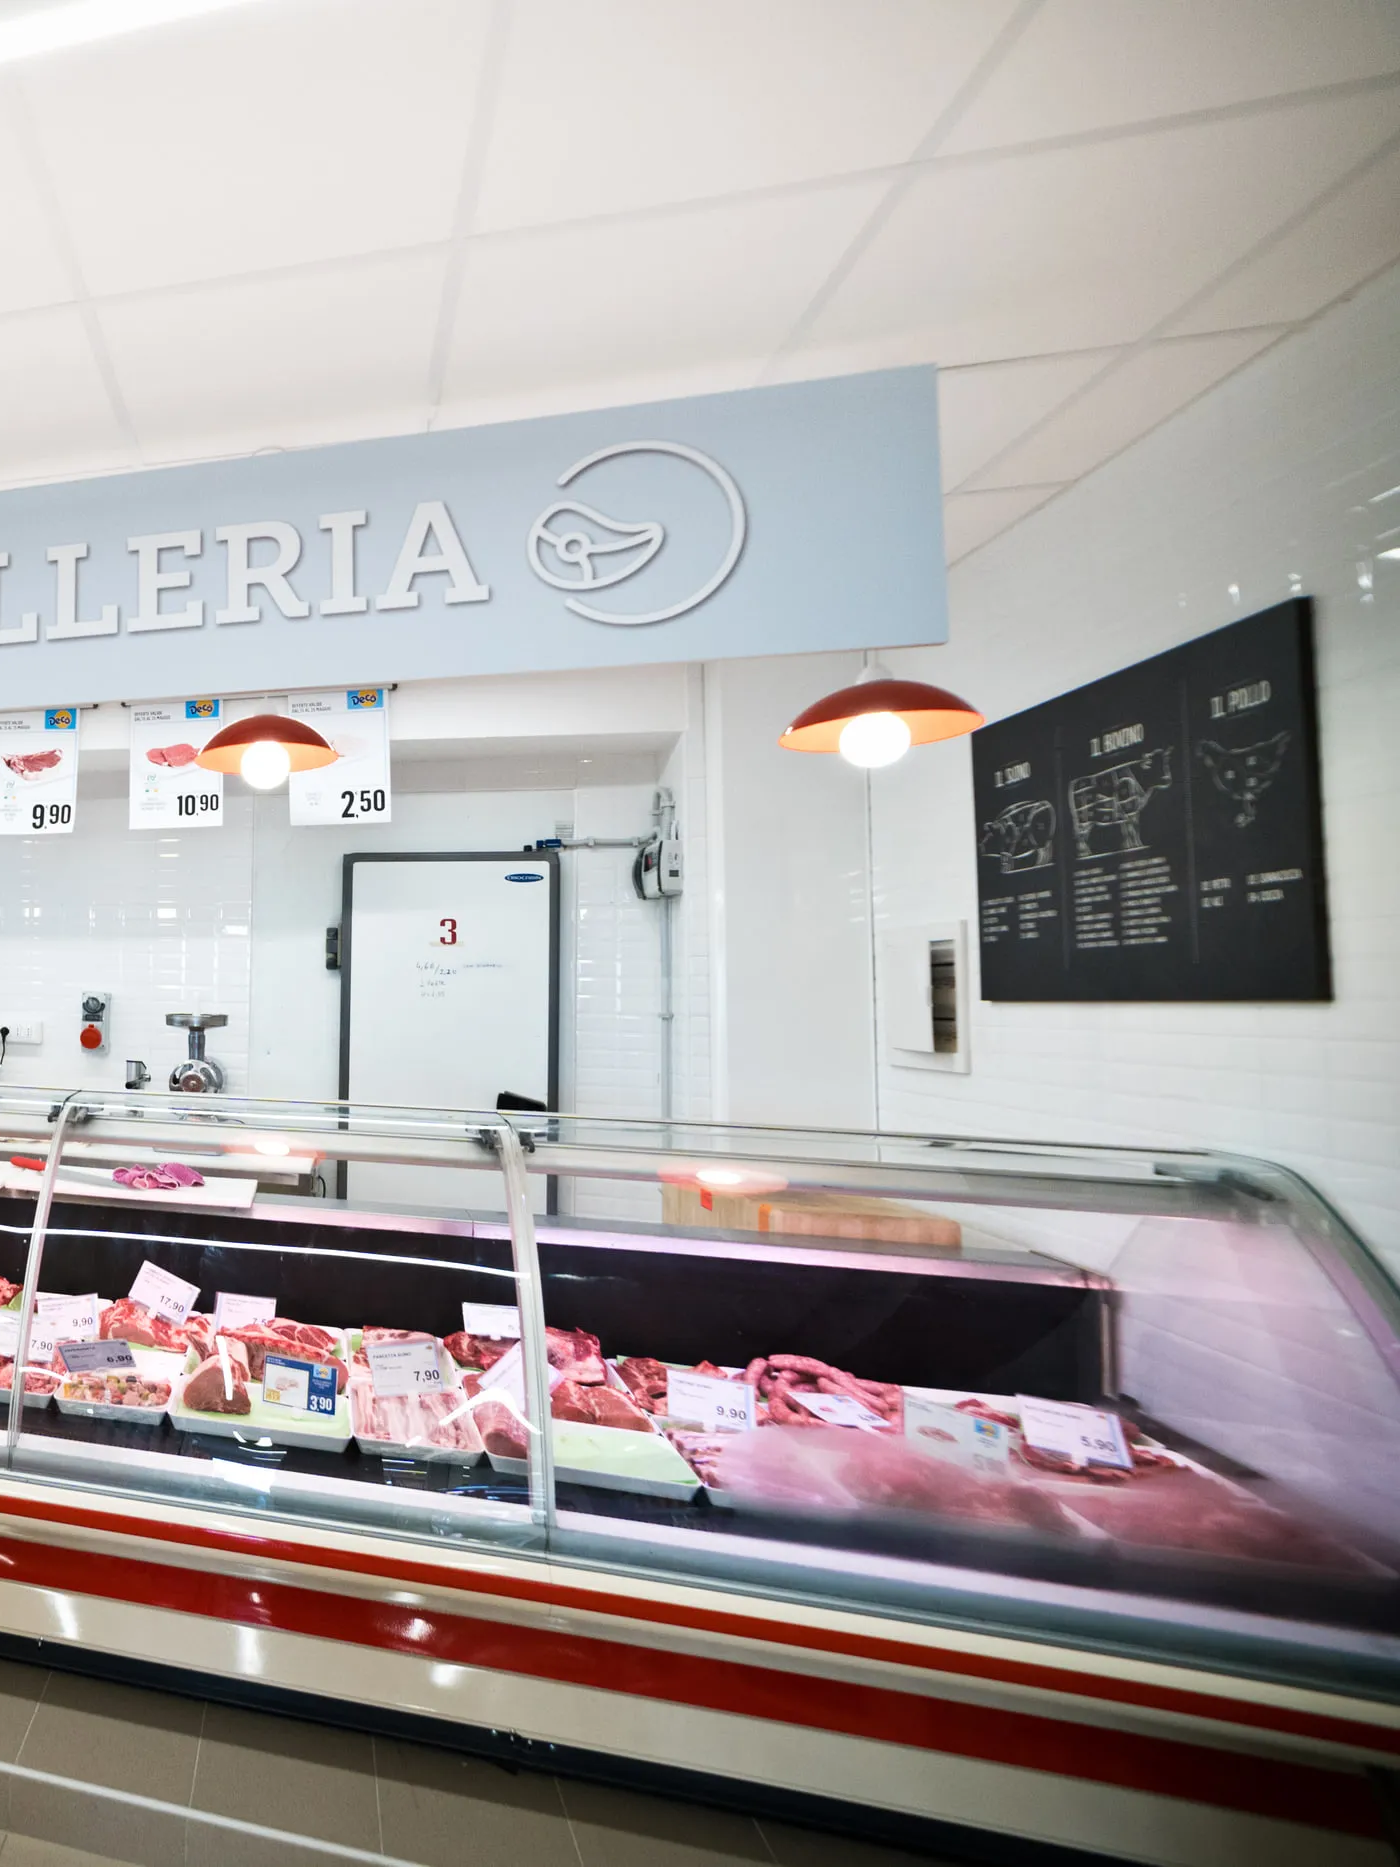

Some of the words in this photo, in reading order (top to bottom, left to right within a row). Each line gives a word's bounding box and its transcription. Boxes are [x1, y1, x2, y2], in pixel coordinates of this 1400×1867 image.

[439, 918, 458, 945] 3
[160, 1295, 184, 1313] 17,90
[72, 1317, 93, 1327] 9,90
[31, 1339, 53, 1351] 7,90
[413, 1370, 440, 1383] 7,90
